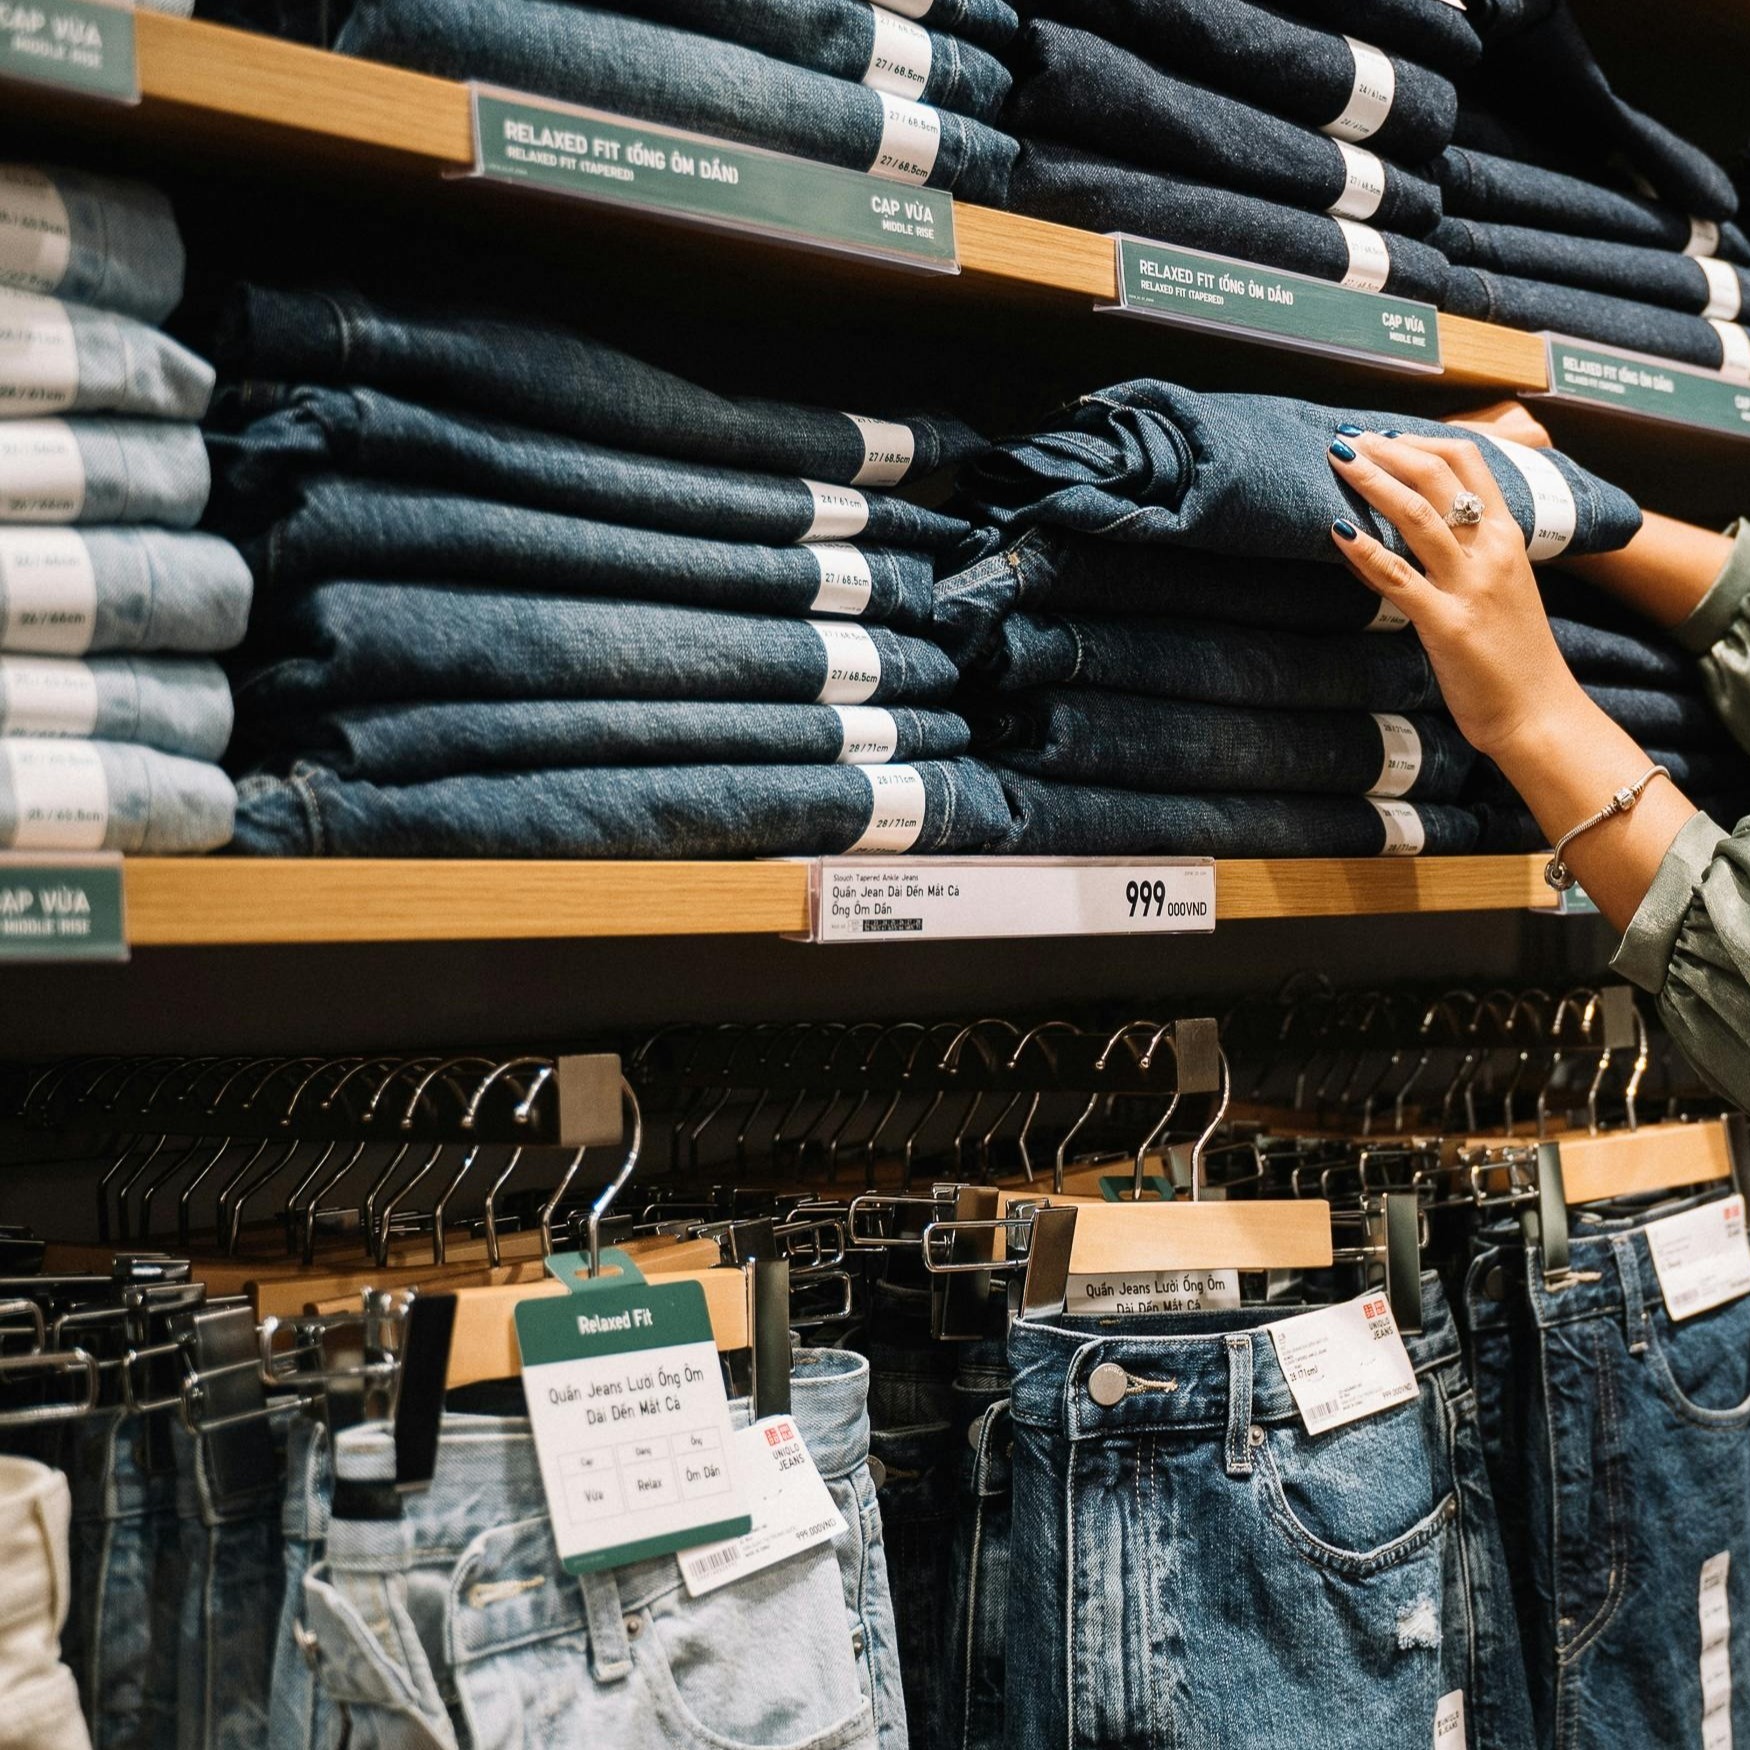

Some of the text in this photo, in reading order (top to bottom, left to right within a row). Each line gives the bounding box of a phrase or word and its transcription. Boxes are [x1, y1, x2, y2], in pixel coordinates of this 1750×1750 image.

[504, 120, 588, 154] RELAXED
[592, 136, 621, 161] FIT
[671, 148, 695, 175] ÔM
[507, 147, 634, 182] RELAXED FIT (TAPERED)
[871, 194, 900, 218] CẠP
[882, 218, 934, 239] MIDDLE RISE
[1139, 259, 1193, 284] RELAXED
[1197, 272, 1214, 289] FIT
[1248, 279, 1264, 300] ÔM
[1141, 280, 1224, 305] RELAXED FIT (TAPERED)
[857, 874, 880, 884] Tapered
[861, 886, 883, 897] Jean
[1126, 880, 1206, 917] 999 000VND
[1119, 1282, 1150, 1295] Jeans
[1207, 1274, 1225, 1290] Ôm
[576, 1308, 653, 1335] Relaxed Fit
[1374, 1325, 1393, 1340] JEANS
[587, 1381, 623, 1398] Jeans
[685, 1362, 704, 1382] Ôm
[772, 1442, 800, 1460] UNIQLO
[779, 1453, 805, 1472] JEANS
[637, 1478, 663, 1492] Relax
